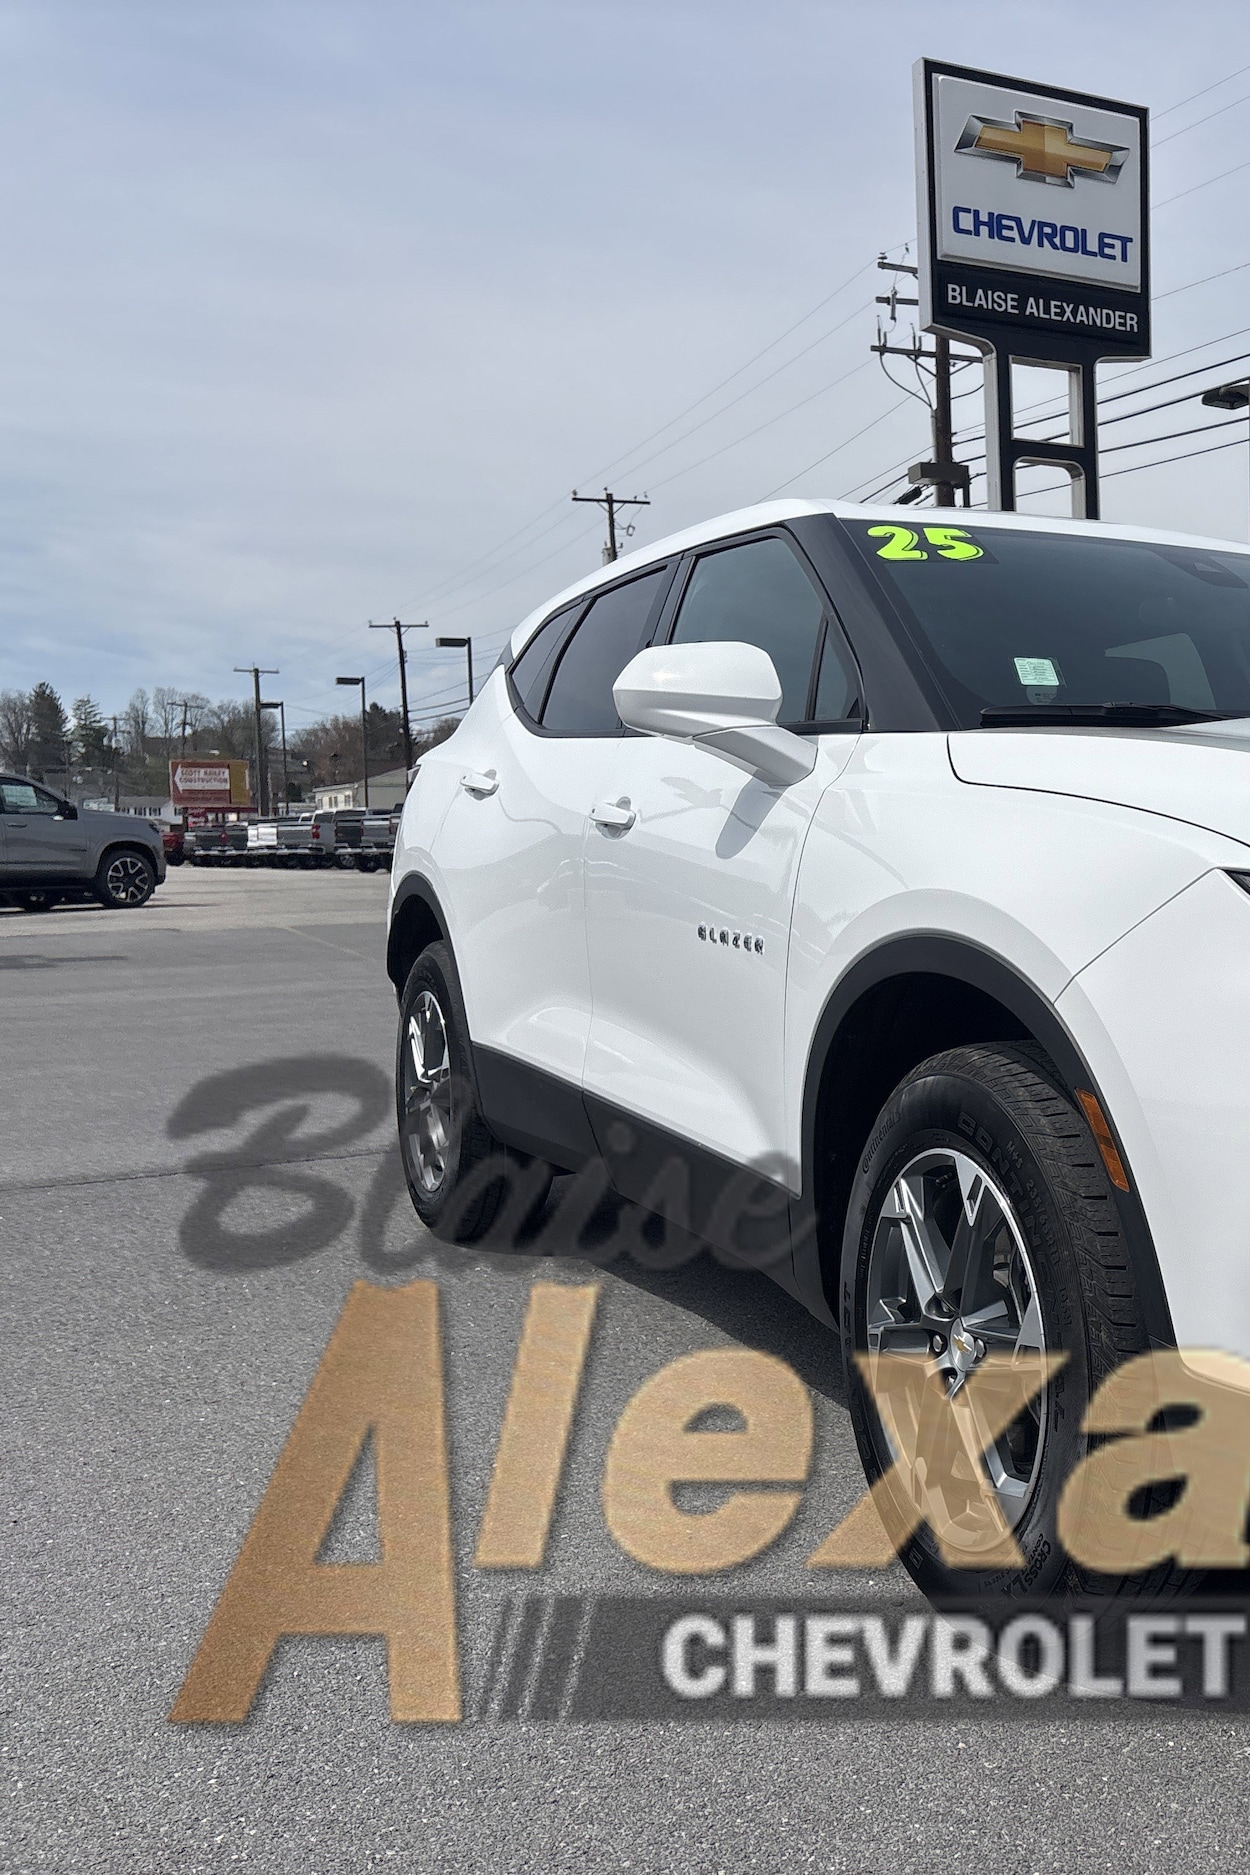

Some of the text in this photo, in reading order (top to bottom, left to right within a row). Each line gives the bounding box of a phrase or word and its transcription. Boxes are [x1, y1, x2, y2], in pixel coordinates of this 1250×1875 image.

[952, 205, 1133, 262] CHEVROLET
[947, 283, 1139, 332] BLAISE ALEXANDER
[867, 525, 984, 561] 25
[698, 924, 764, 955] BLAZER
